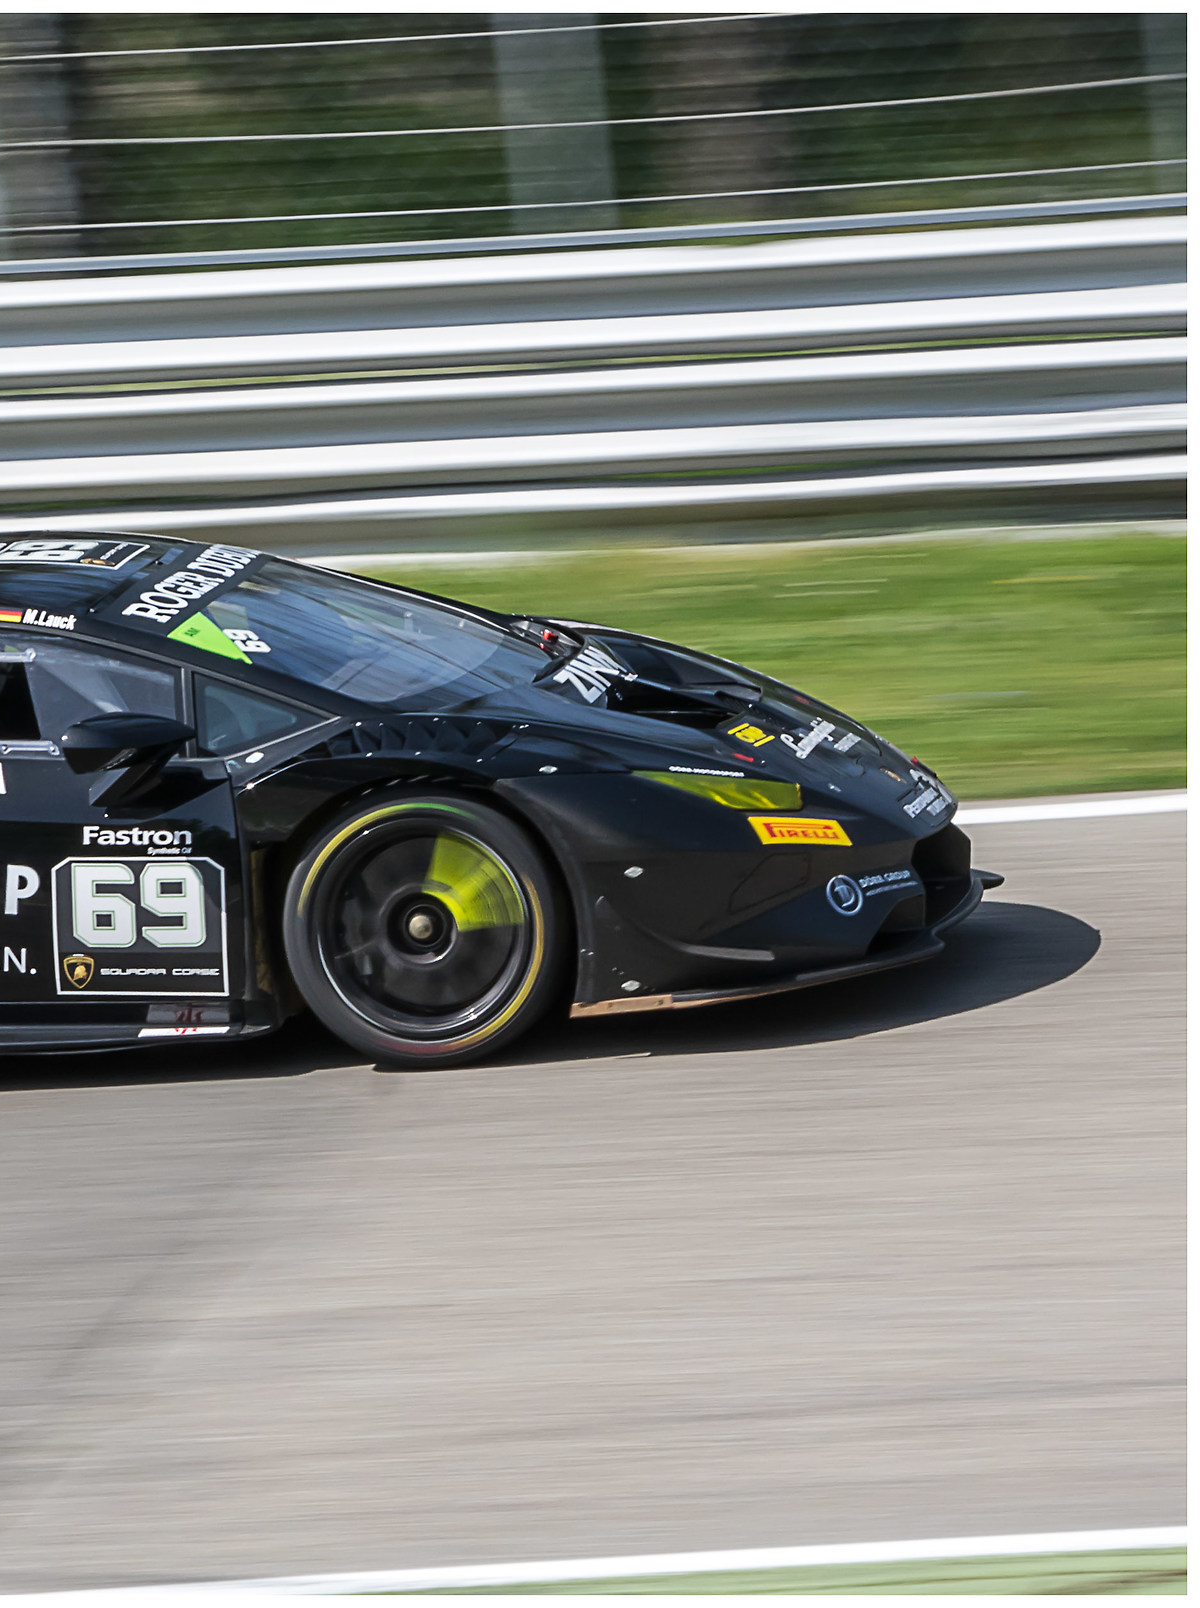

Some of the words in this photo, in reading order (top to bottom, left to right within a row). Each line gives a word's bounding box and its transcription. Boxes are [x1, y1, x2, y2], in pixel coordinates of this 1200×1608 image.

[121, 571, 225, 624] ROGER
[22, 609, 77, 630] M.Lauck
[222, 629, 271, 653] 69
[82, 825, 192, 845] Fastron
[762, 823, 841, 840] PIRELLI
[71, 862, 206, 948] 69
